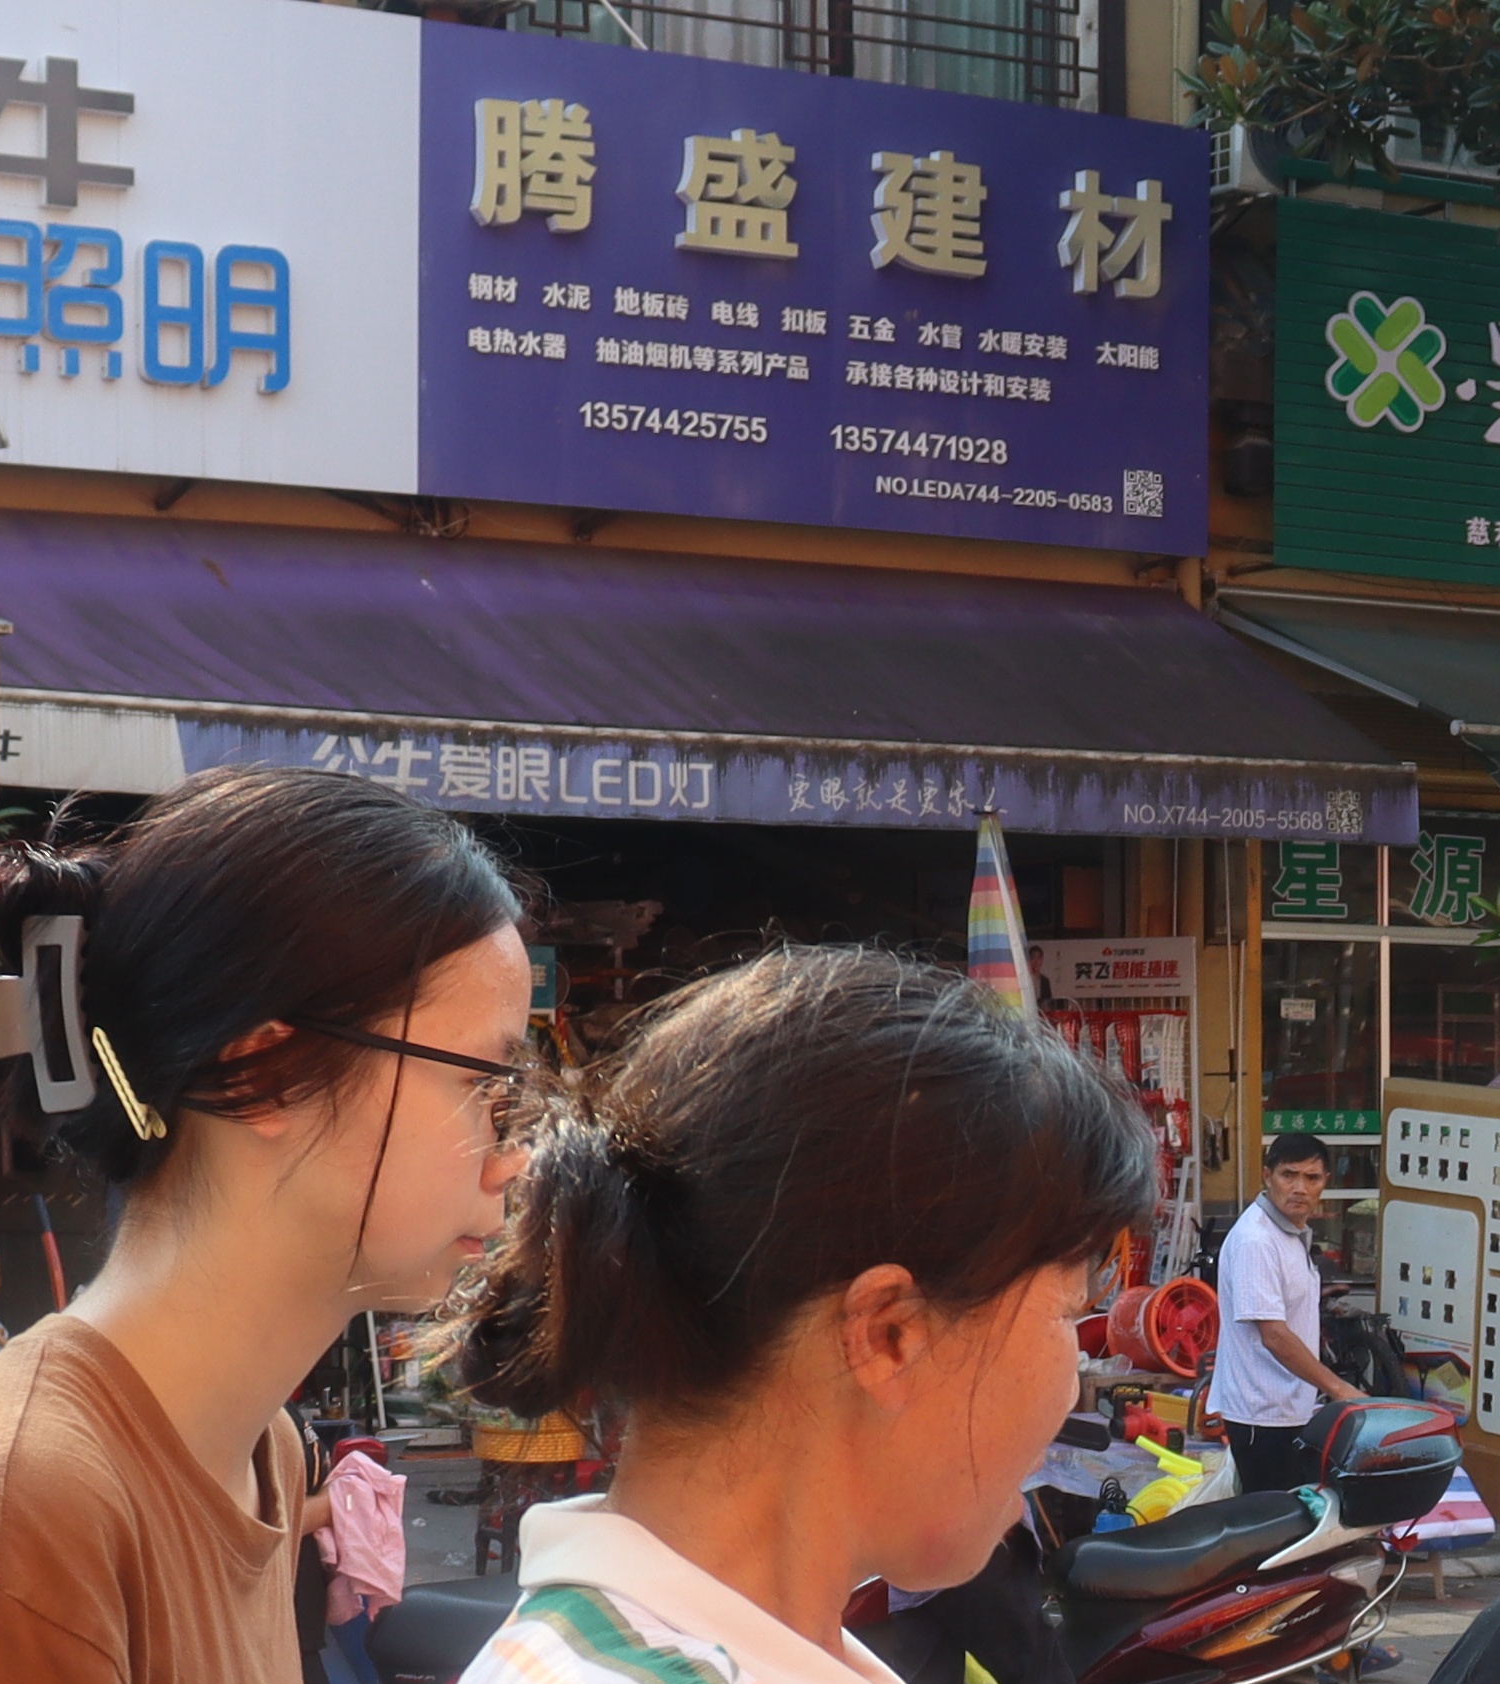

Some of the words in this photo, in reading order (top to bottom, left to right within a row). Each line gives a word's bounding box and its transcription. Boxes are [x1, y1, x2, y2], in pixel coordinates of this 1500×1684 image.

[469, 97, 1172, 299] 腾盛建材
[468, 273, 518, 302] 钢材
[543, 282, 591, 311] 水泥
[614, 286, 689, 321] 地板砖
[711, 301, 760, 328] 电线
[781, 307, 827, 335] 扣板
[849, 315, 896, 343] 五金
[918, 322, 962, 350] 水管
[978, 329, 1068, 360] 水暖安装
[1096, 342, 1159, 370] 太阳能
[468, 326, 567, 360] 电热水器
[596, 337, 810, 381] 抽油烟机等系列产品
[846, 361, 1051, 402] 承接各种设计和安装
[579, 402, 768, 444] 13574425755
[830, 425, 1008, 464] 13574471928
[876, 476, 1113, 514] NO.LEDA744-2205-0583
[1123, 803, 1323, 832] NO.X744-2005-5568
